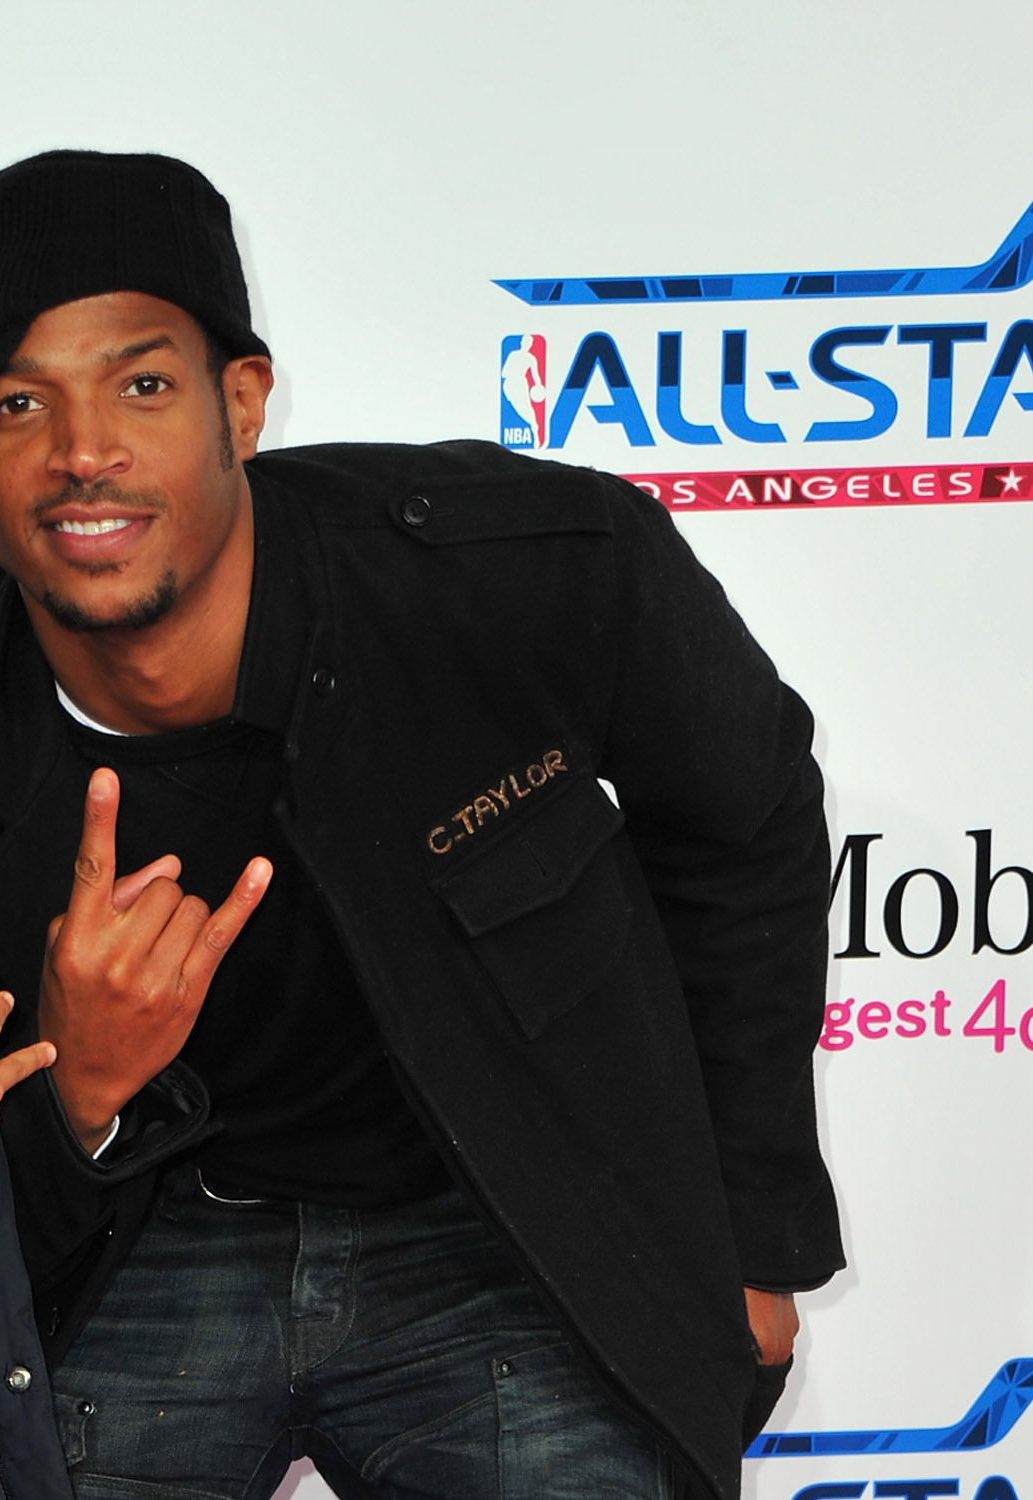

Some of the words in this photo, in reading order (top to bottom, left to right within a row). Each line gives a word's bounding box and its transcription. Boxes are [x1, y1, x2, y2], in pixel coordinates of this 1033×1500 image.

[546, 319, 1033, 448] ALL-STA
[503, 427, 532, 445] NBA
[725, 471, 973, 503] ANGELES
[819, 978, 952, 1051] gest
